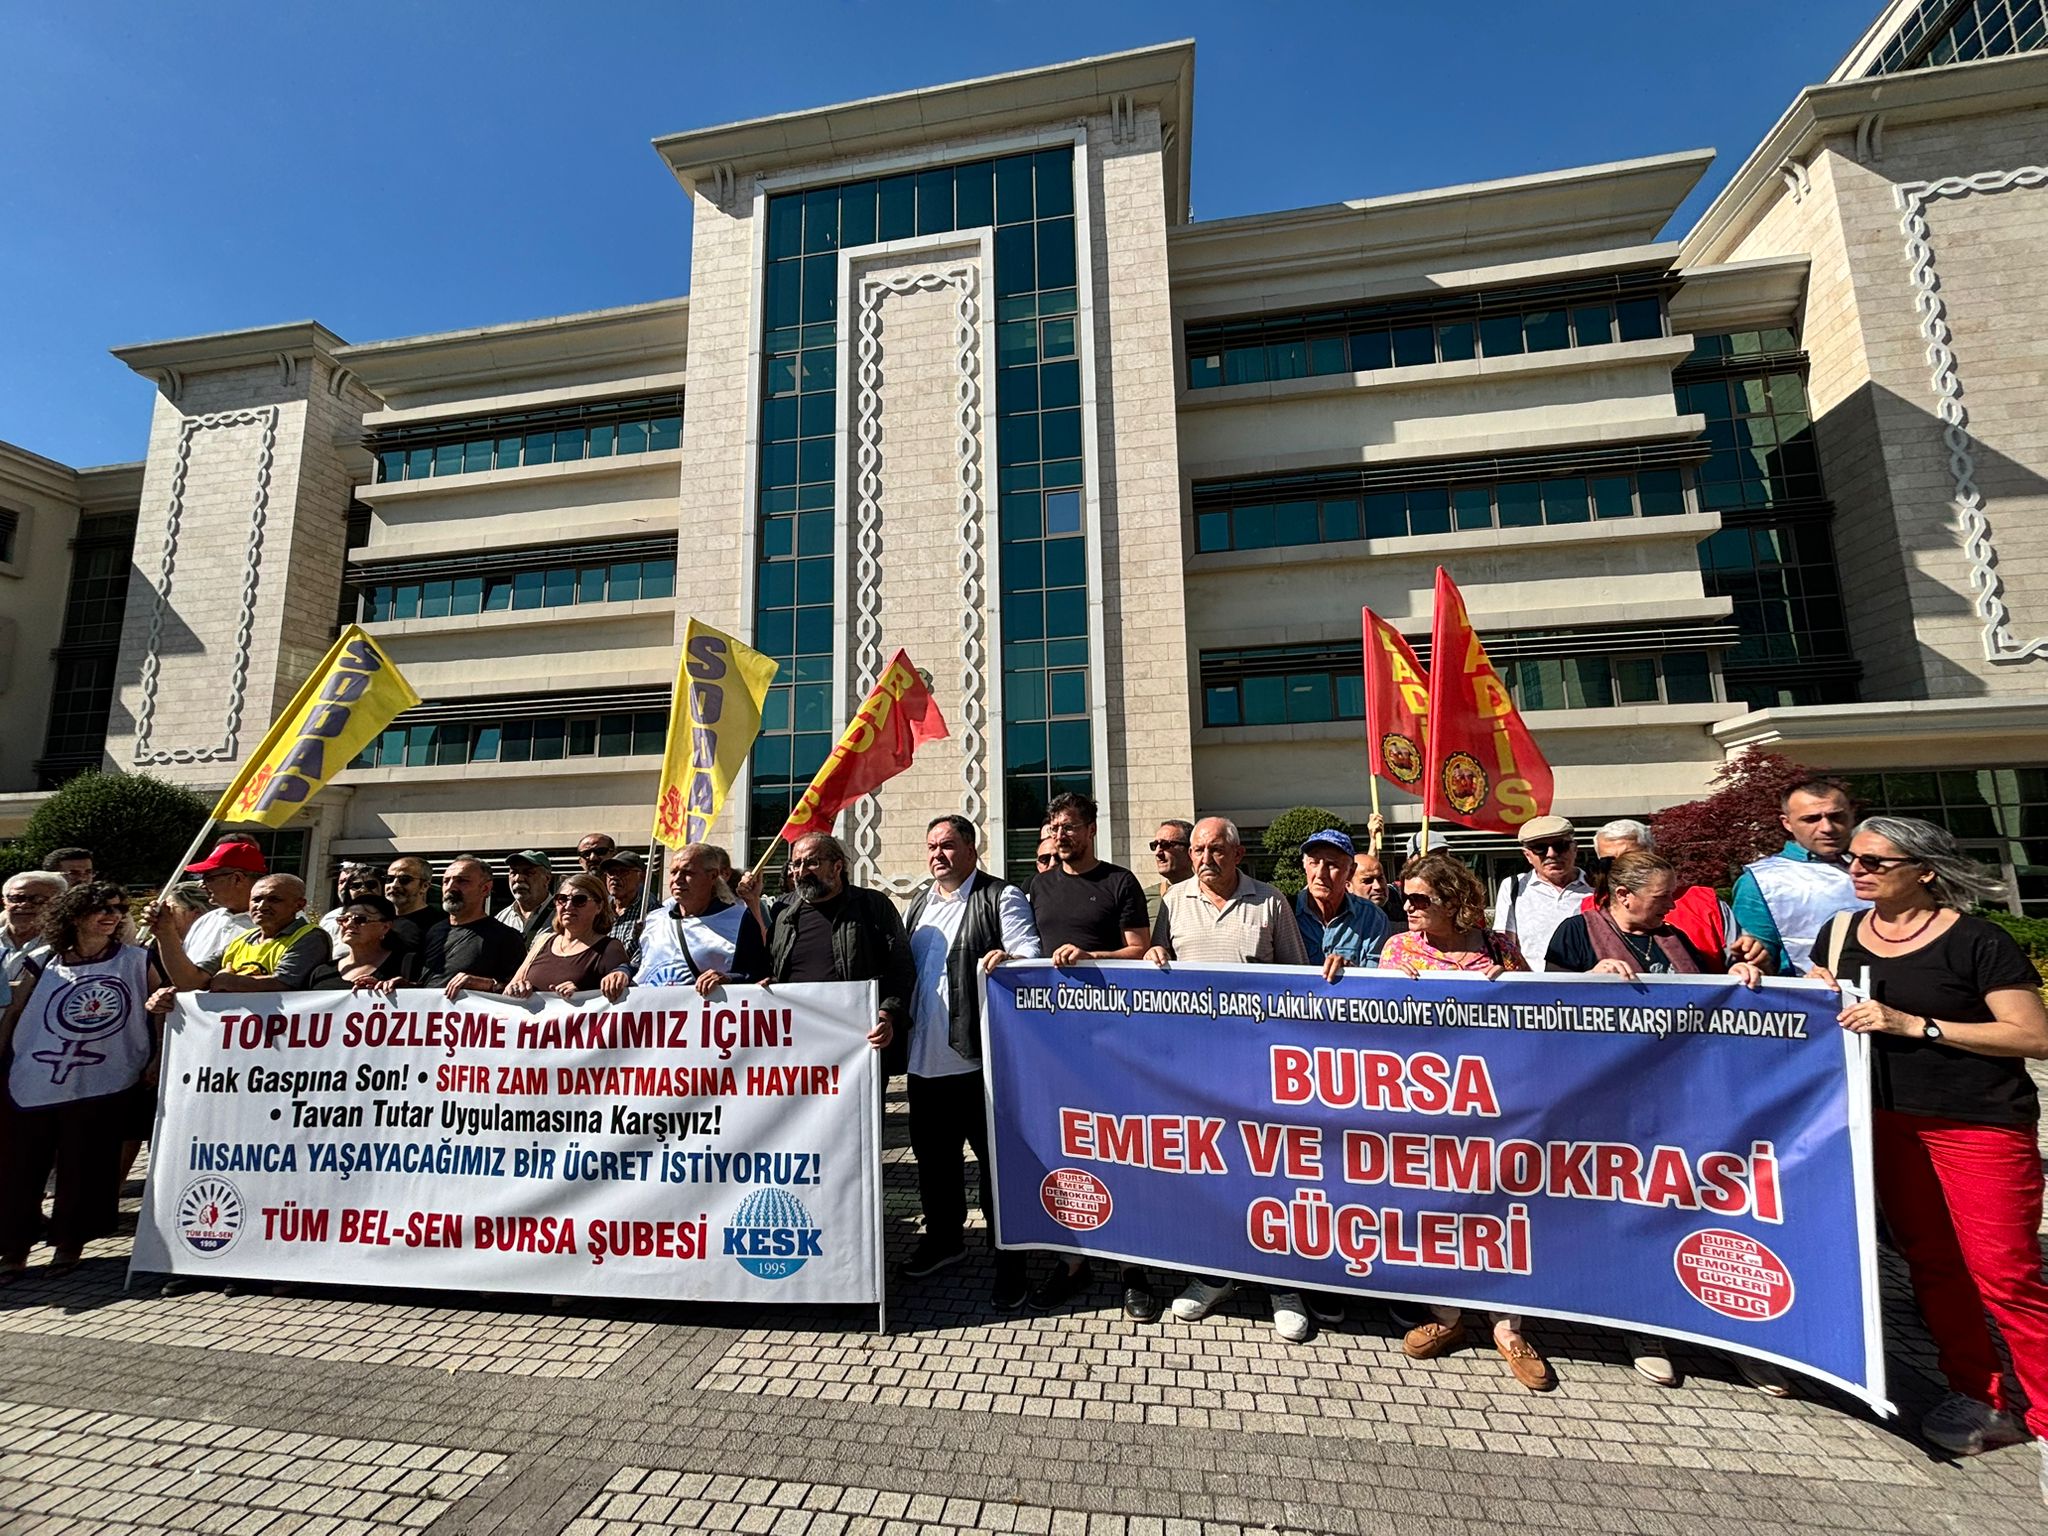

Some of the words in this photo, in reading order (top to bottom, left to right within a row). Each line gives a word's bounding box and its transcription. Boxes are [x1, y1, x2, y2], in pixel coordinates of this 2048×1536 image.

[1015, 987, 1055, 1014] EMEK,
[1057, 984, 1131, 1016] ÖZGÜRLÜK,
[1132, 987, 1217, 1020] DEMOKRASİ,
[1219, 992, 1266, 1022] BARIŞ,
[1267, 991, 1323, 1021] LAİKLİK
[1325, 999, 1348, 1021] VE
[1349, 995, 1432, 1026] EKOLOJİYE
[1434, 998, 1510, 1030] YÖNELEN
[1512, 1001, 1616, 1034] TEHDİTLERE
[1618, 1010, 1672, 1040] KARŞI
[1677, 1004, 1704, 1034] BİR
[1708, 1009, 1808, 1040] ARADAYIZ
[220, 1012, 333, 1050] TOPLU
[343, 1003, 507, 1057] SÖZLEŞME
[516, 1010, 688, 1050] HAKKIMIZ
[700, 1000, 792, 1060] İÇİN!
[196, 1066, 238, 1093] Hak
[247, 1066, 347, 1098] Gaspına
[355, 1064, 410, 1093] Son!
[436, 1064, 490, 1094] SIFIR
[497, 1066, 548, 1095] ZAM
[557, 1067, 737, 1096] DAYATMASINA
[746, 1065, 839, 1096] HAYIR!
[1270, 1046, 1500, 1116] BURSA
[292, 1100, 363, 1128] Tavan
[373, 1100, 434, 1128] Tutar
[441, 1101, 601, 1136] Uygulamasına
[610, 1105, 722, 1142] Karşıyız!
[189, 1136, 297, 1172] İNSANCA
[307, 1138, 505, 1180] YAŞAYACAĞIMIZ
[513, 1141, 555, 1180] BİR
[563, 1143, 653, 1181] ÜCRET
[660, 1144, 821, 1185] İSTİYORUZ!
[1058, 1107, 1228, 1176] EMEK
[1238, 1121, 1324, 1181] VE
[1343, 1129, 1784, 1225] DEMOKRASİ
[1058, 1181, 1085, 1190] EMEK
[1059, 1173, 1091, 1183] BURSA
[1056, 1199, 1097, 1211] GÜÇLERİ
[1058, 1211, 1096, 1224] BEDG
[185, 1229, 201, 1237] TÜM
[262, 1201, 334, 1242] TÜM
[339, 1208, 463, 1249] BEL-SEN
[474, 1215, 577, 1254] BURSA
[587, 1213, 708, 1265] ŞUBESİ
[723, 1227, 824, 1256] KESK
[1247, 1187, 1533, 1277] GÜÇLERİ
[1703, 1235, 1755, 1252] BURSA
[758, 1261, 786, 1275] 1995
[1702, 1246, 1746, 1262] EMEK
[1684, 1255, 1781, 1283] DEMOKRASİ
[1700, 1271, 1768, 1294] GÜÇLERİ
[1703, 1288, 1766, 1314] BEDG
